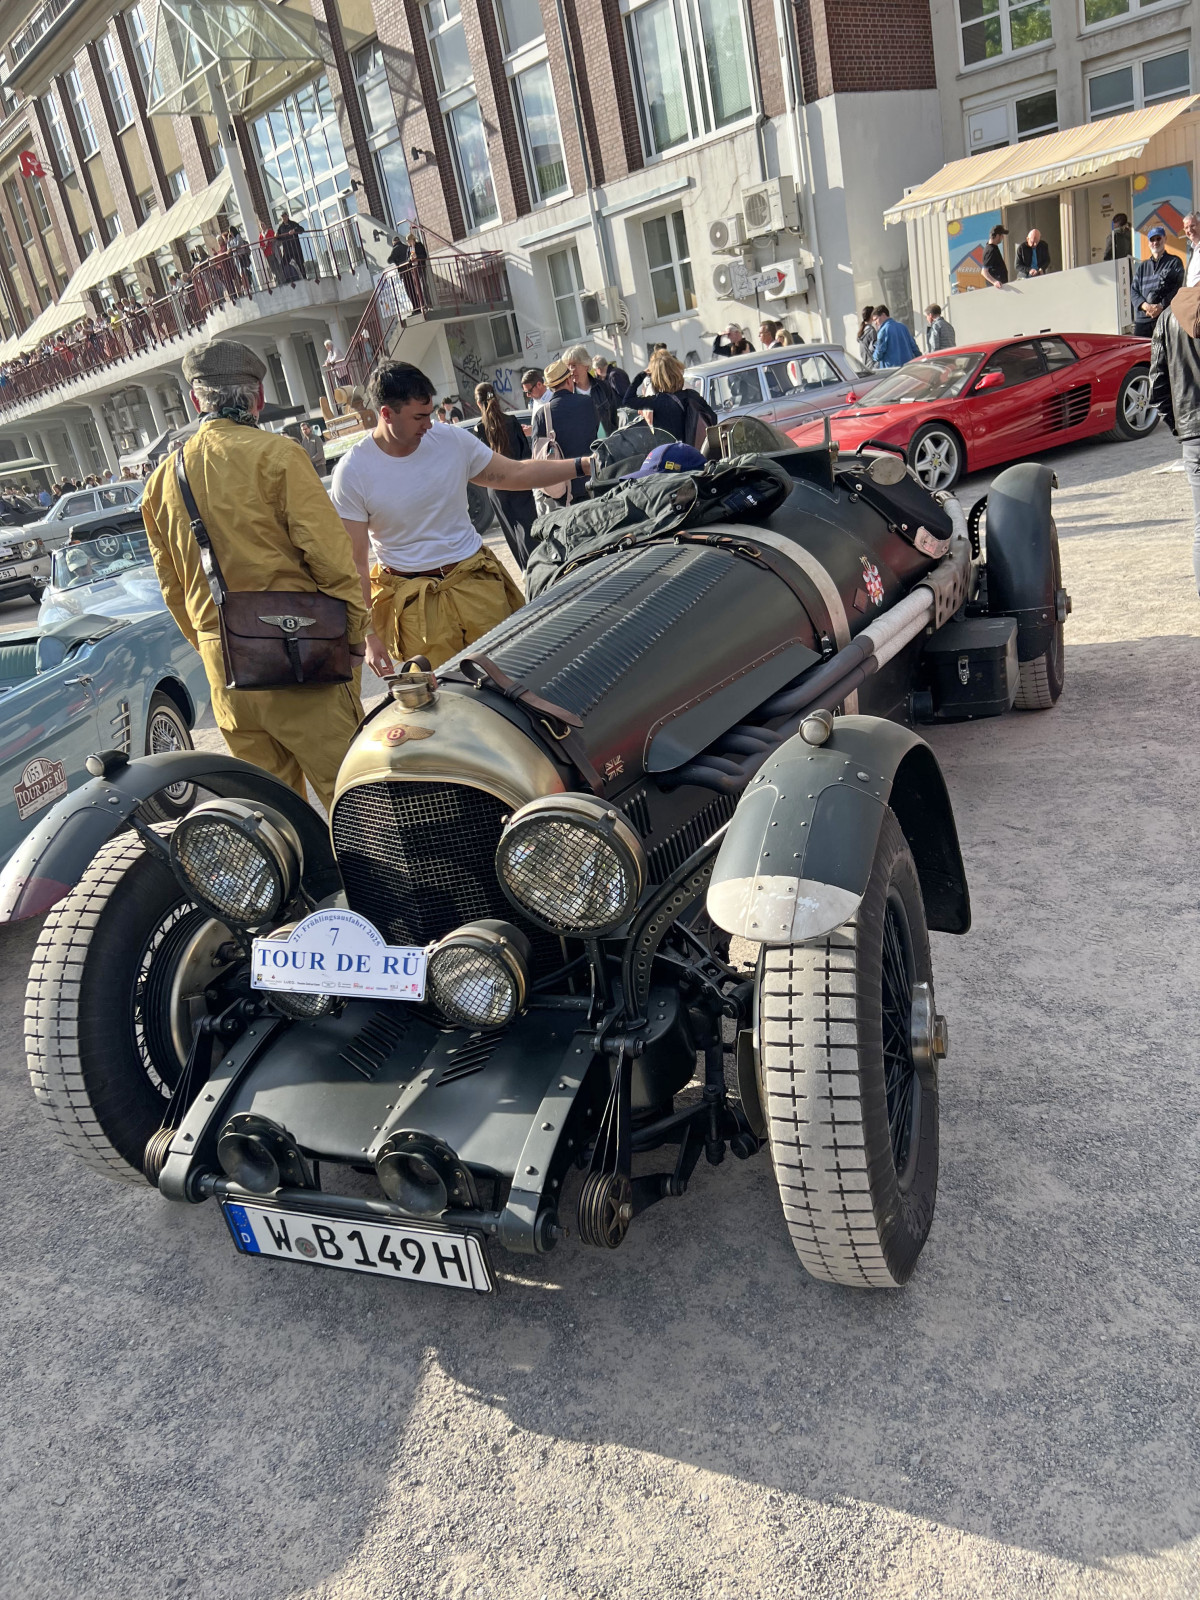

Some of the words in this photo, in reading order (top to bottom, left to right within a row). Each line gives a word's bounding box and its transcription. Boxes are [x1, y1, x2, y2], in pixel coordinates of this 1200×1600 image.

[17, 784, 42, 807] TOUR
[42, 777, 54, 792] DE
[54, 765, 65, 784] RÜ
[302, 914, 367, 933] Frühlingsausfahrt
[366, 929, 381, 947] 2025
[330, 927, 340, 946] 7
[258, 948, 326, 971] TOUR
[336, 953, 371, 973] DE
[382, 952, 421, 976] RÜ
[241, 1232, 251, 1244] D
